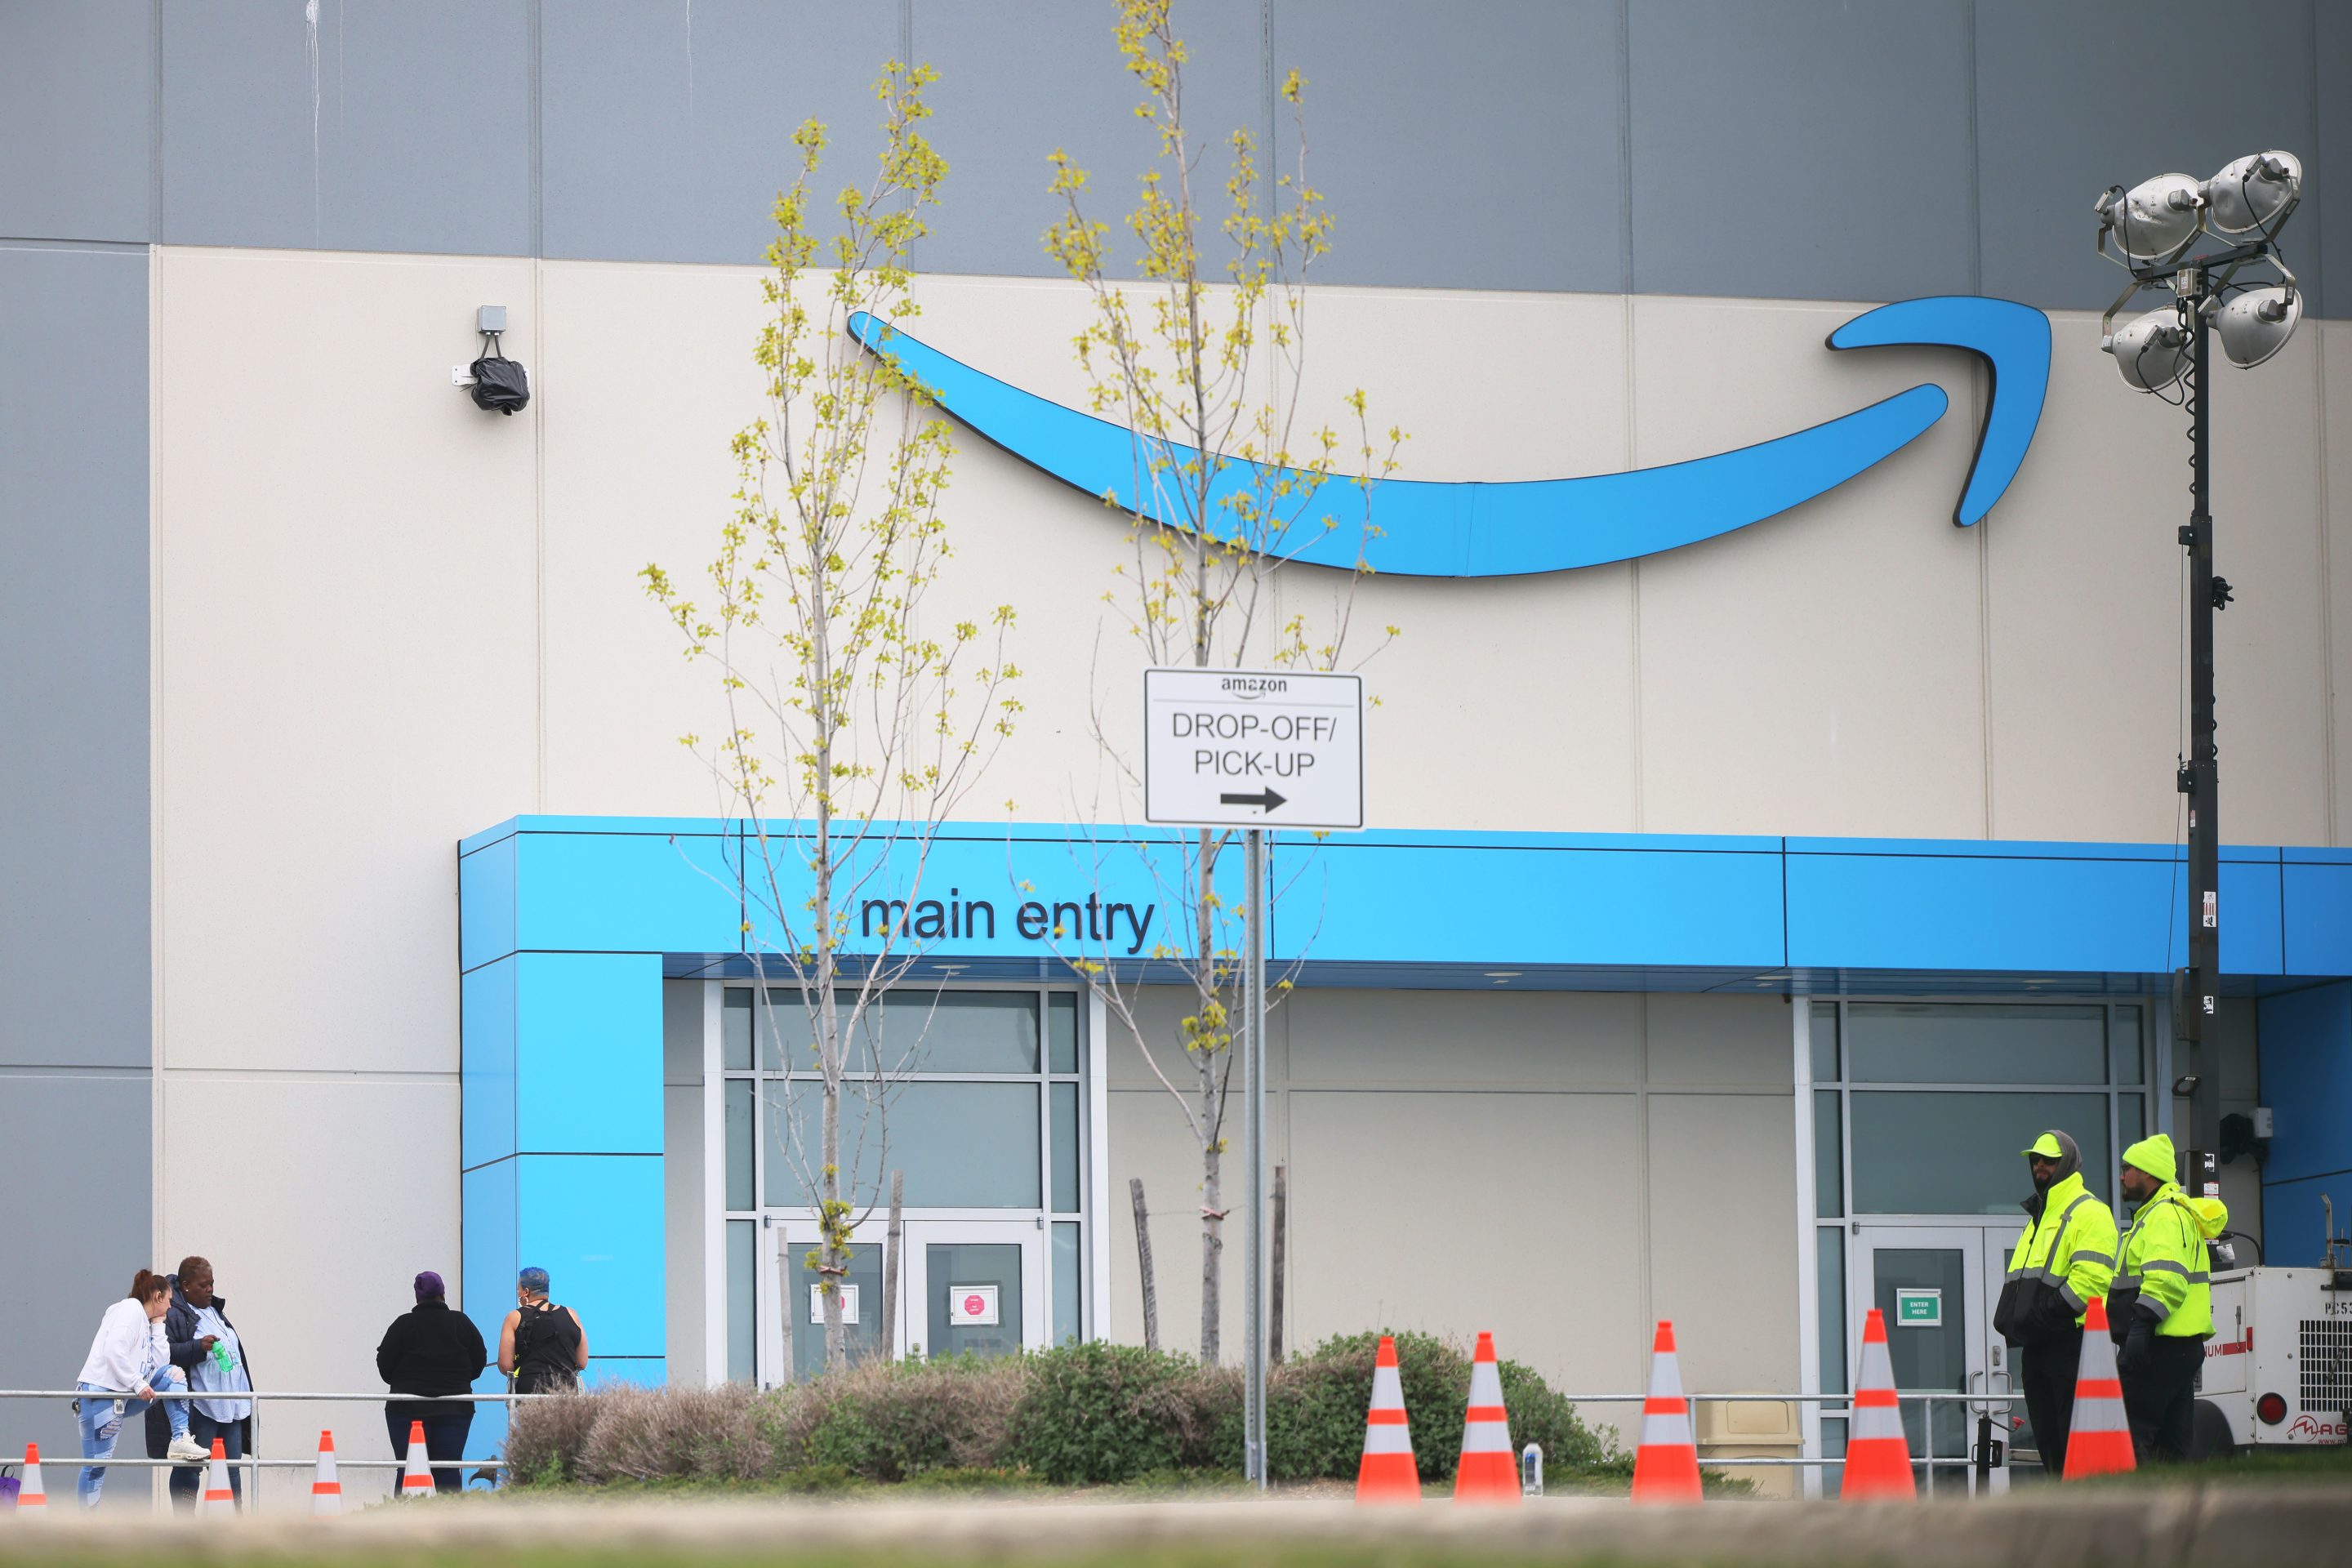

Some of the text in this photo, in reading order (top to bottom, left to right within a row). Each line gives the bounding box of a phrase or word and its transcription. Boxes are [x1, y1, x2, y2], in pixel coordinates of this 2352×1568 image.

[1222, 677, 1287, 693] amazon
[1173, 712, 1337, 742] DROP-OFF/
[1195, 750, 1315, 777] PICK-UP
[862, 888, 1155, 954] main entry
